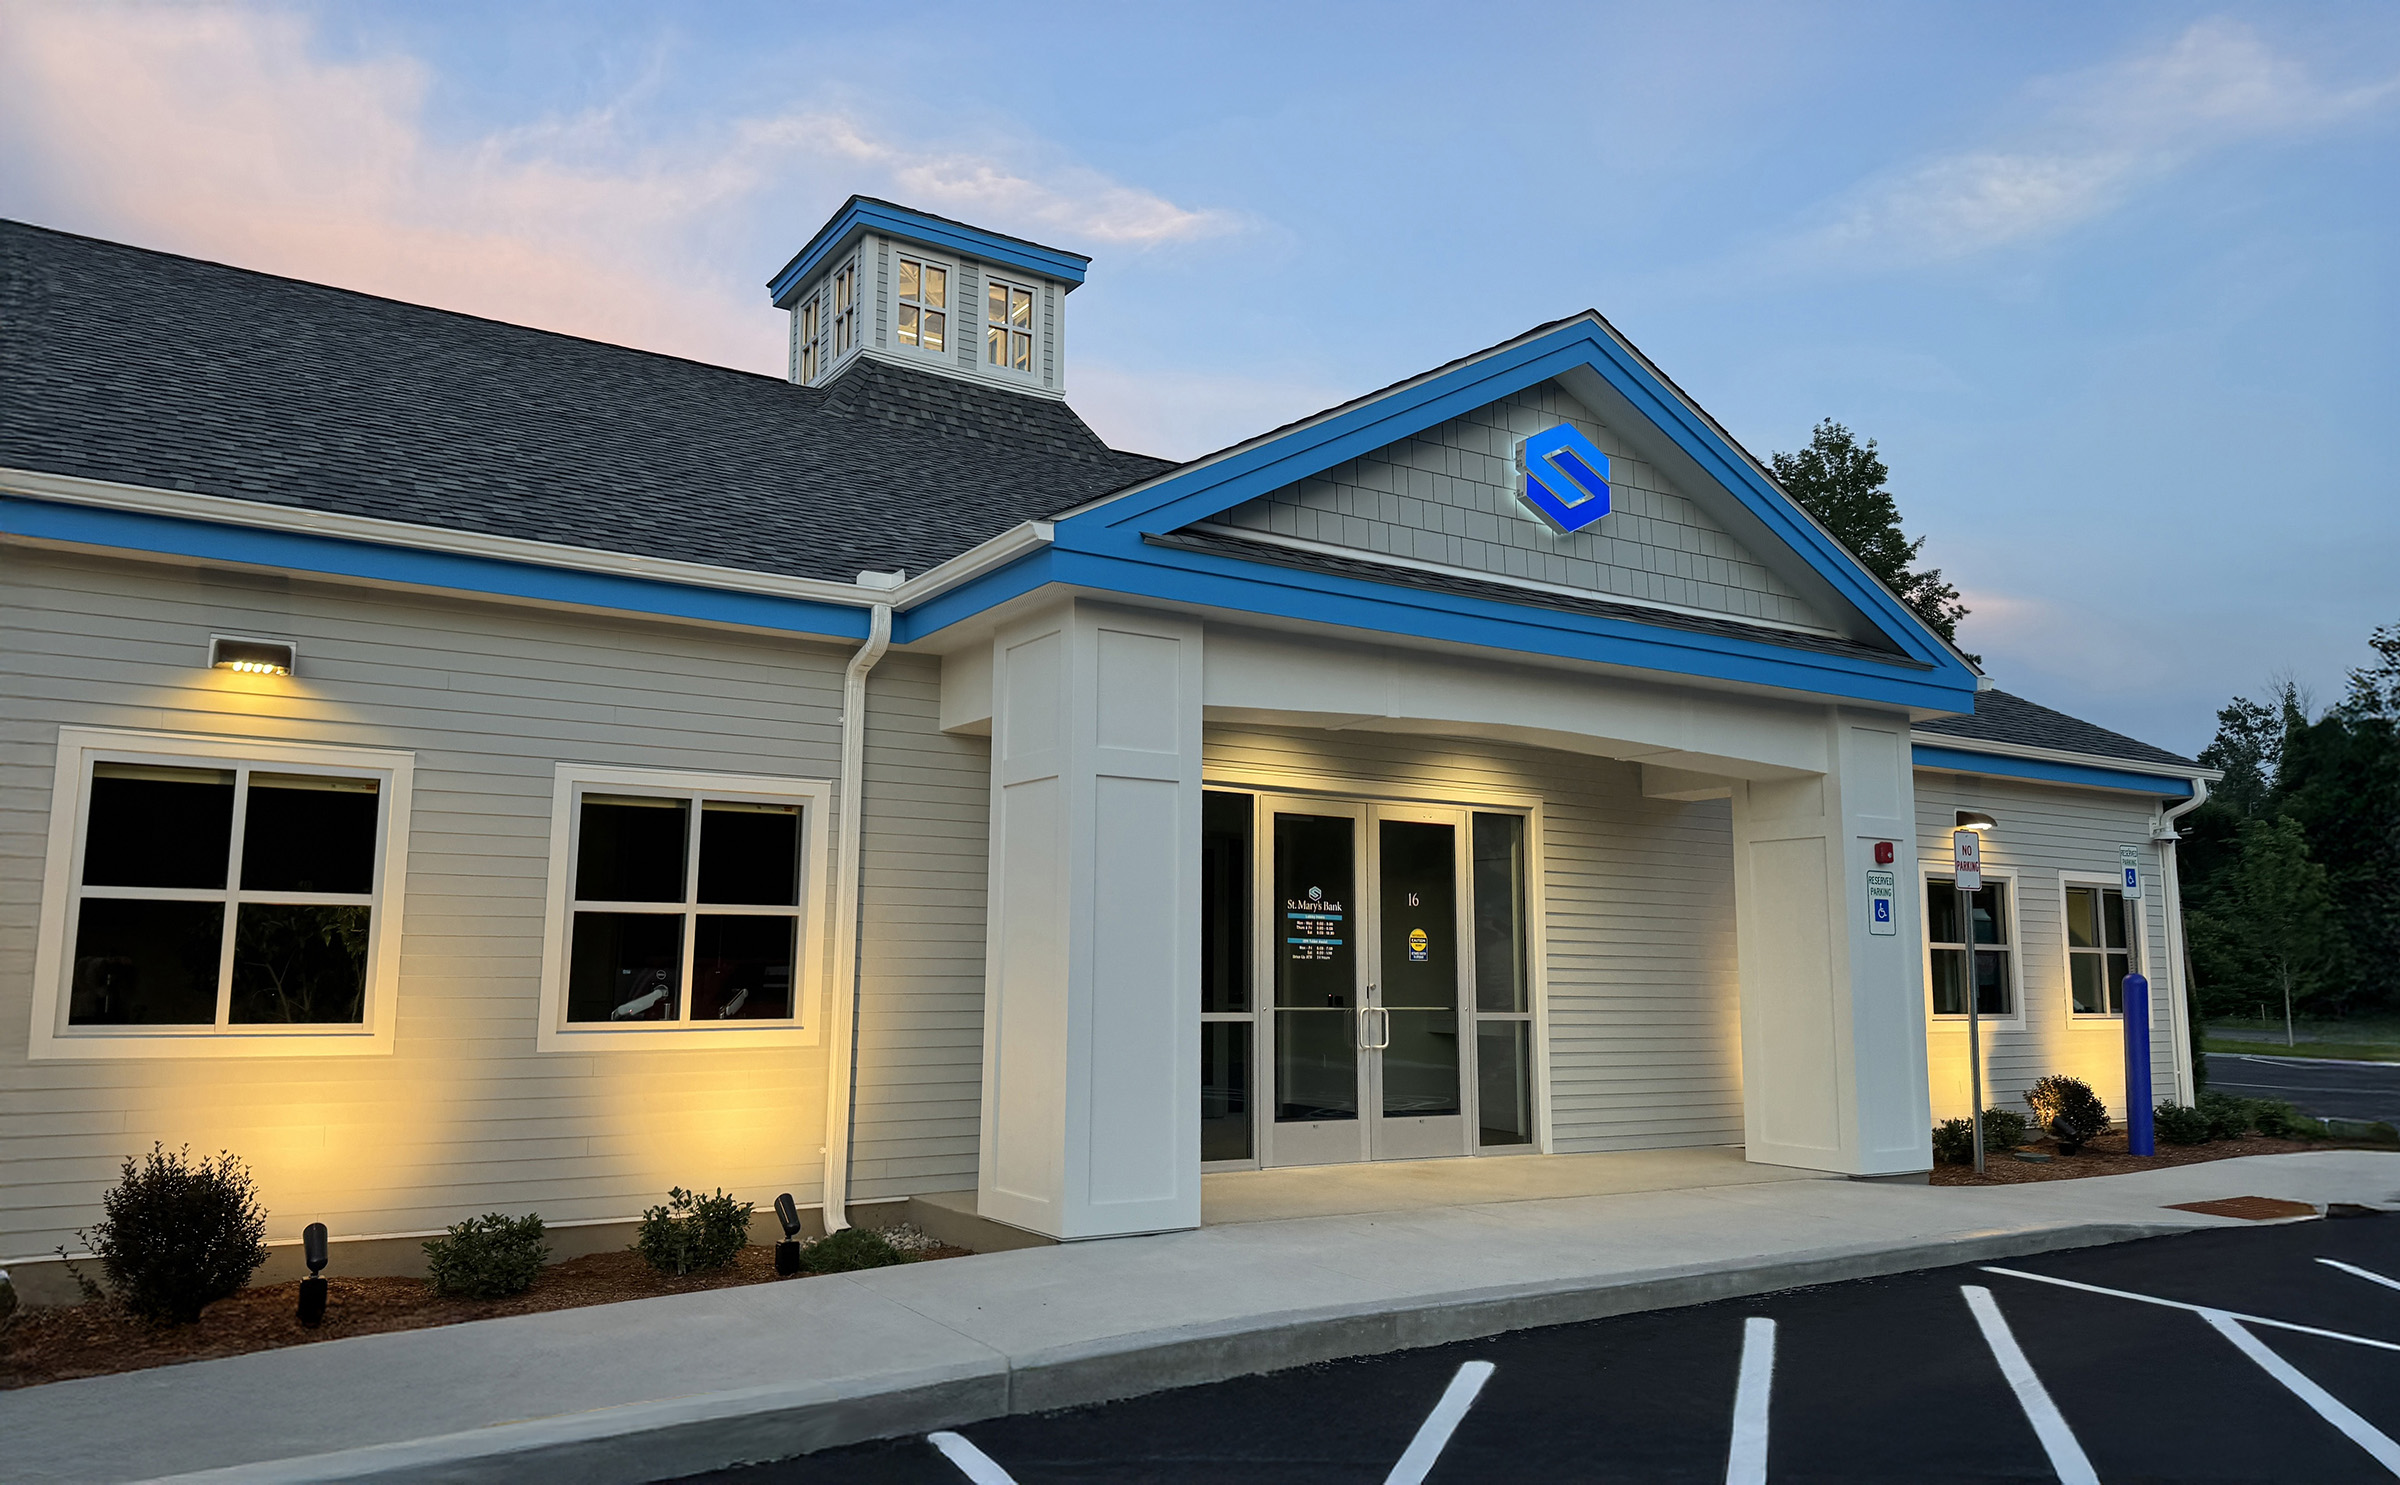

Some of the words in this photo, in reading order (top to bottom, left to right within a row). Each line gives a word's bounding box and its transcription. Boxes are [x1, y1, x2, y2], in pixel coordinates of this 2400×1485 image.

[1962, 845, 1972, 856] NO
[1956, 861, 1979, 872] PARKING
[1868, 875, 1892, 885] RESERVED
[1870, 887, 1891, 897] PARKING
[1408, 892, 1420, 907] 16
[1287, 899, 1297, 910] St.
[1297, 899, 1322, 913] Mary's
[1323, 901, 1343, 912] Bank
